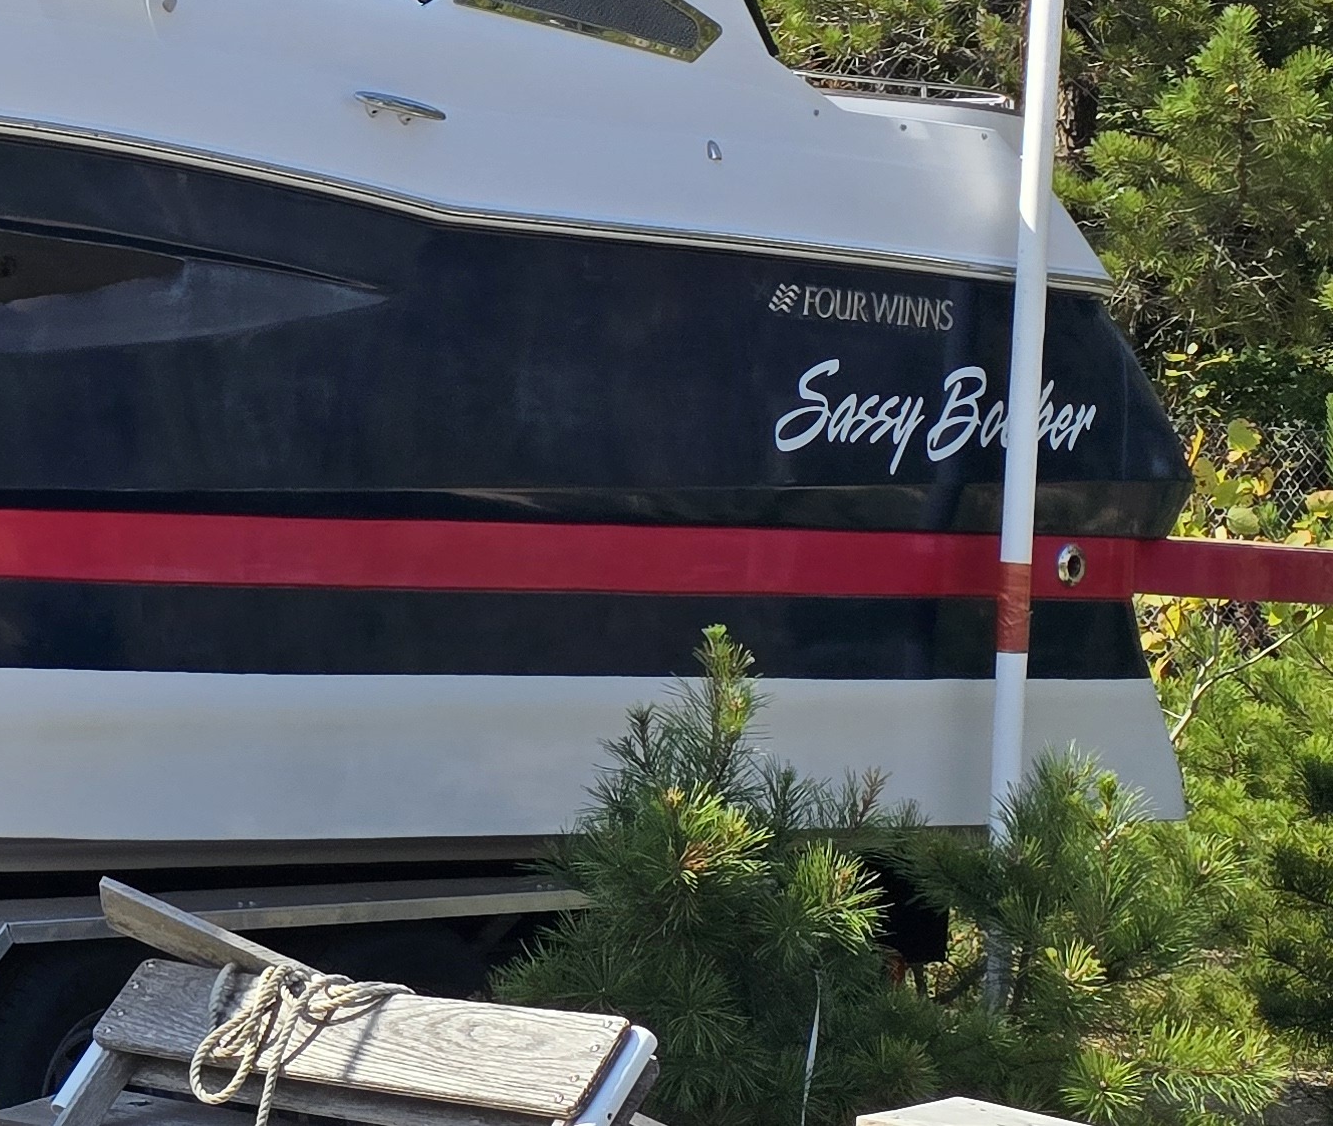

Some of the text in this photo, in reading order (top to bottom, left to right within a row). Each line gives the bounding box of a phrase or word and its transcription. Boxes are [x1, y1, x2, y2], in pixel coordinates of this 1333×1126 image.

[802, 286, 954, 331] FOUR WINNS
[775, 358, 925, 475] Sassy
